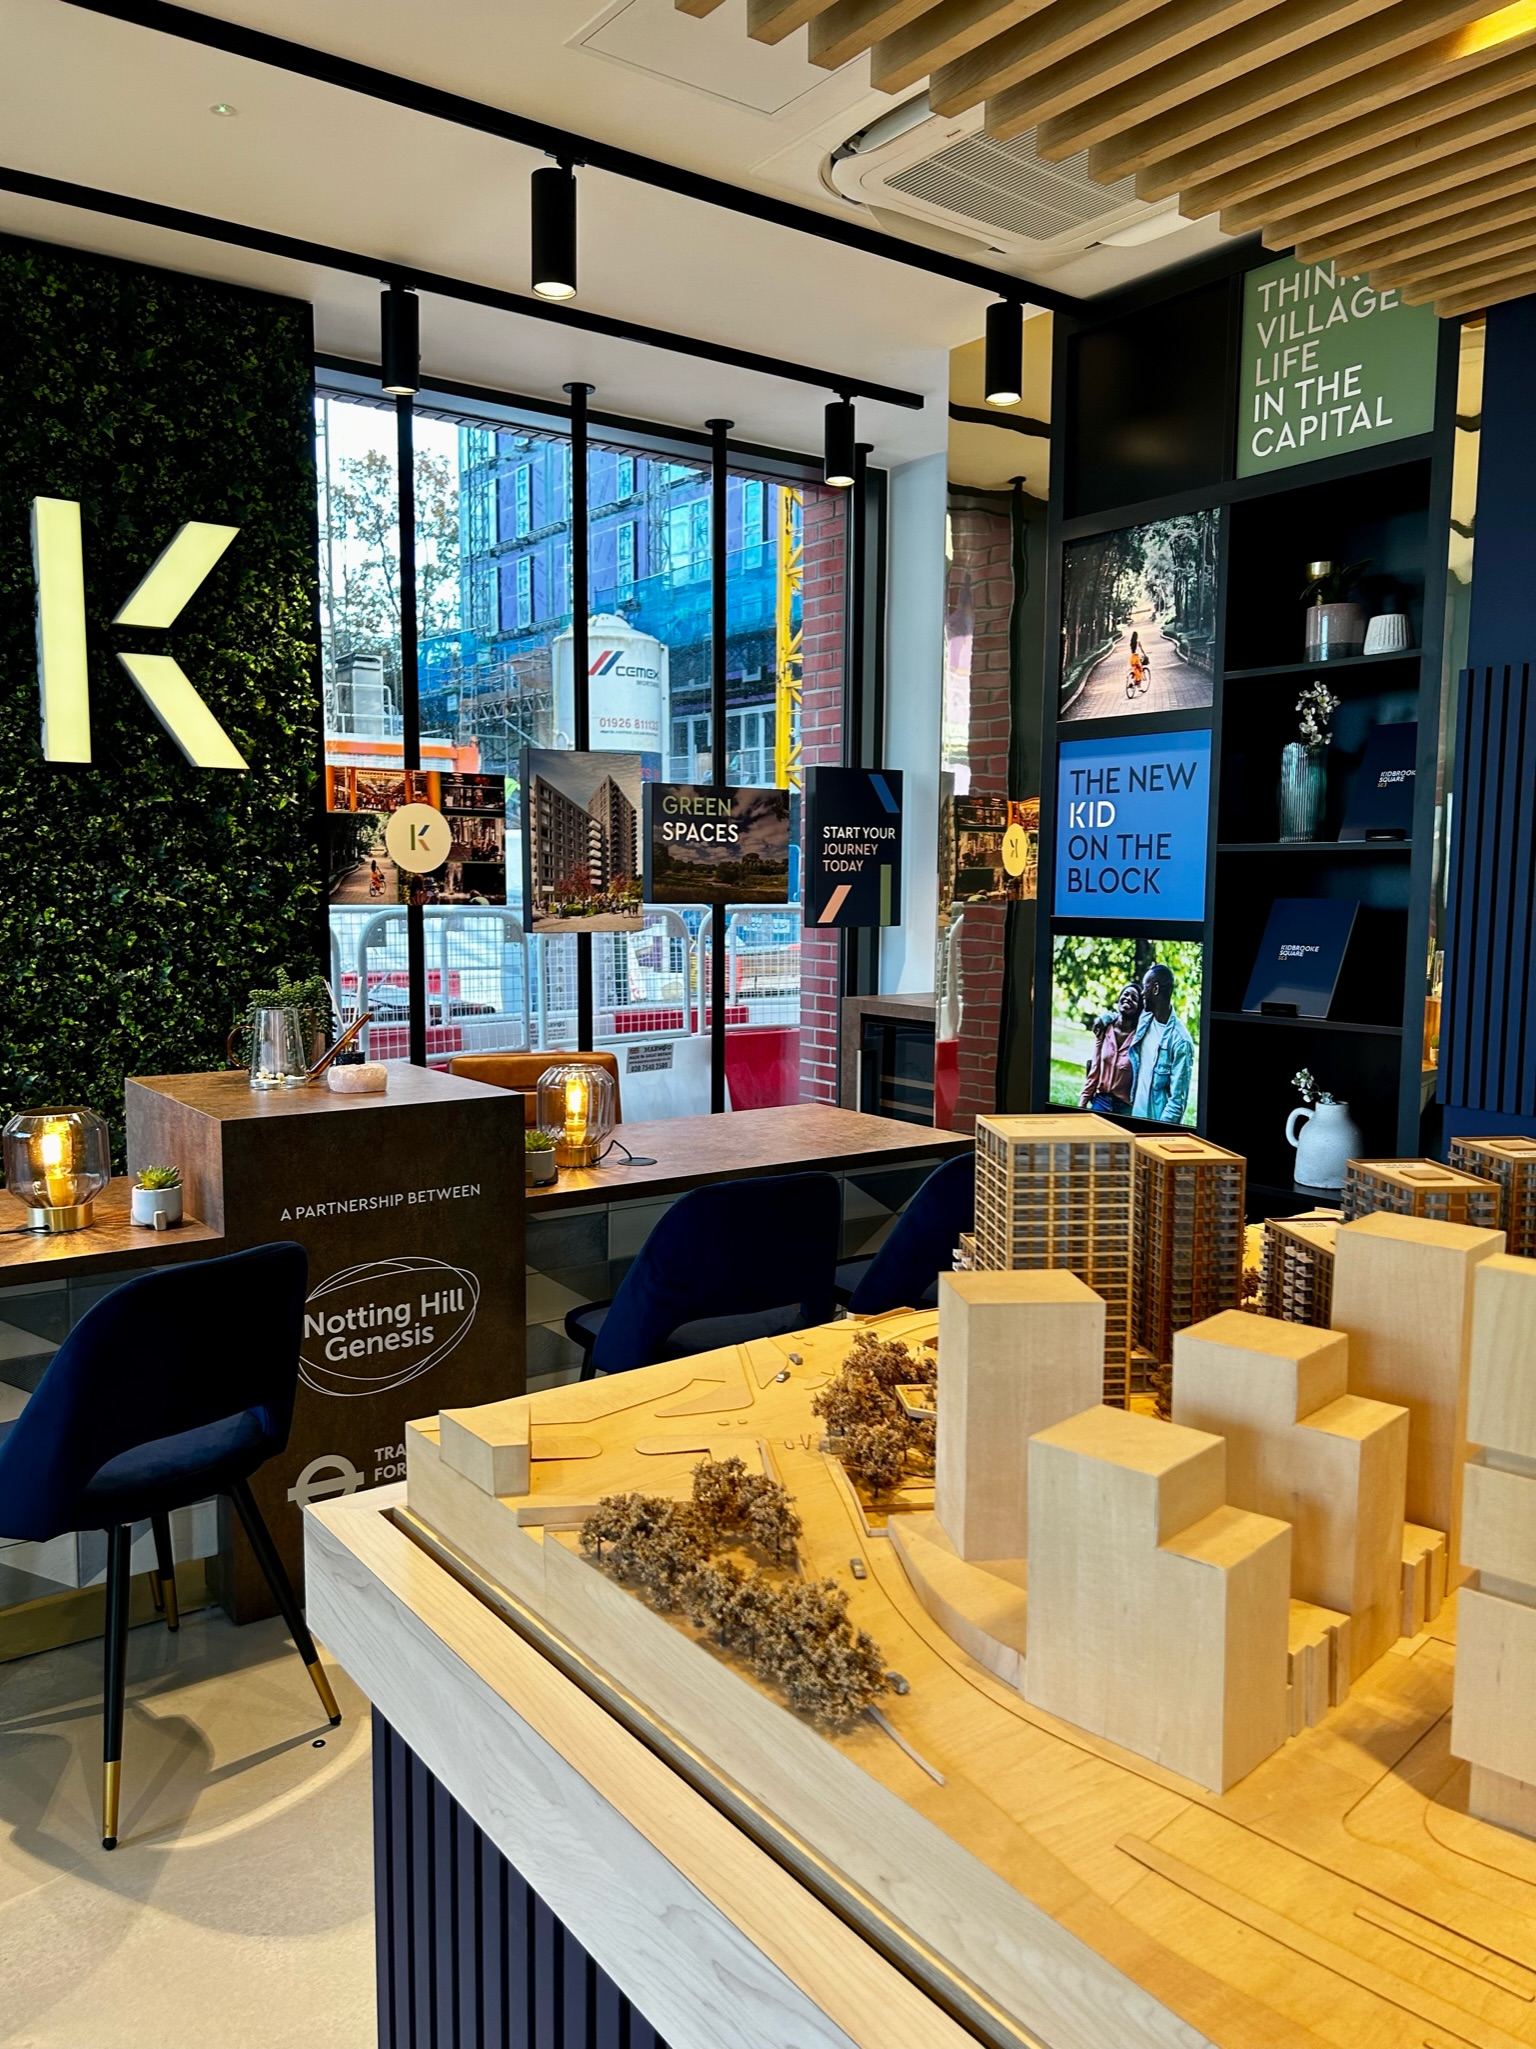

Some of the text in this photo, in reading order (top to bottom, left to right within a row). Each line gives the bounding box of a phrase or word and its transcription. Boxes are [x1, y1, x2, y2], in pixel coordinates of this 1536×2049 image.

[1256, 286, 1399, 349] VILLAGE
[1255, 339, 1320, 387] LIFE
[1253, 364, 1363, 423] IN THE
[1251, 396, 1393, 457] CAPITAL
[30, 496, 250, 769] K
[600, 717, 631, 729] 01926
[1070, 762, 1198, 795] THE NEW
[1380, 769, 1416, 778] KIDBROOK
[662, 795, 732, 817] GREEN
[1070, 800, 1116, 828] KID
[410, 824, 430, 852] K
[662, 822, 739, 843] SPACES
[822, 826, 896, 840] START YOUR
[822, 843, 879, 856] JOURNEY
[1068, 833, 1172, 861] ON THE
[822, 860, 864, 872] TODAY
[1068, 867, 1161, 894] BLOCK
[1280, 944, 1320, 952] KIDBROOKE
[280, 1184, 481, 1221] A PARTNERSHIP BETWEEN
[304, 1288, 465, 1339] Notting Hill
[325, 1323, 434, 1361] Genesis
[374, 1443, 407, 1462] TRA
